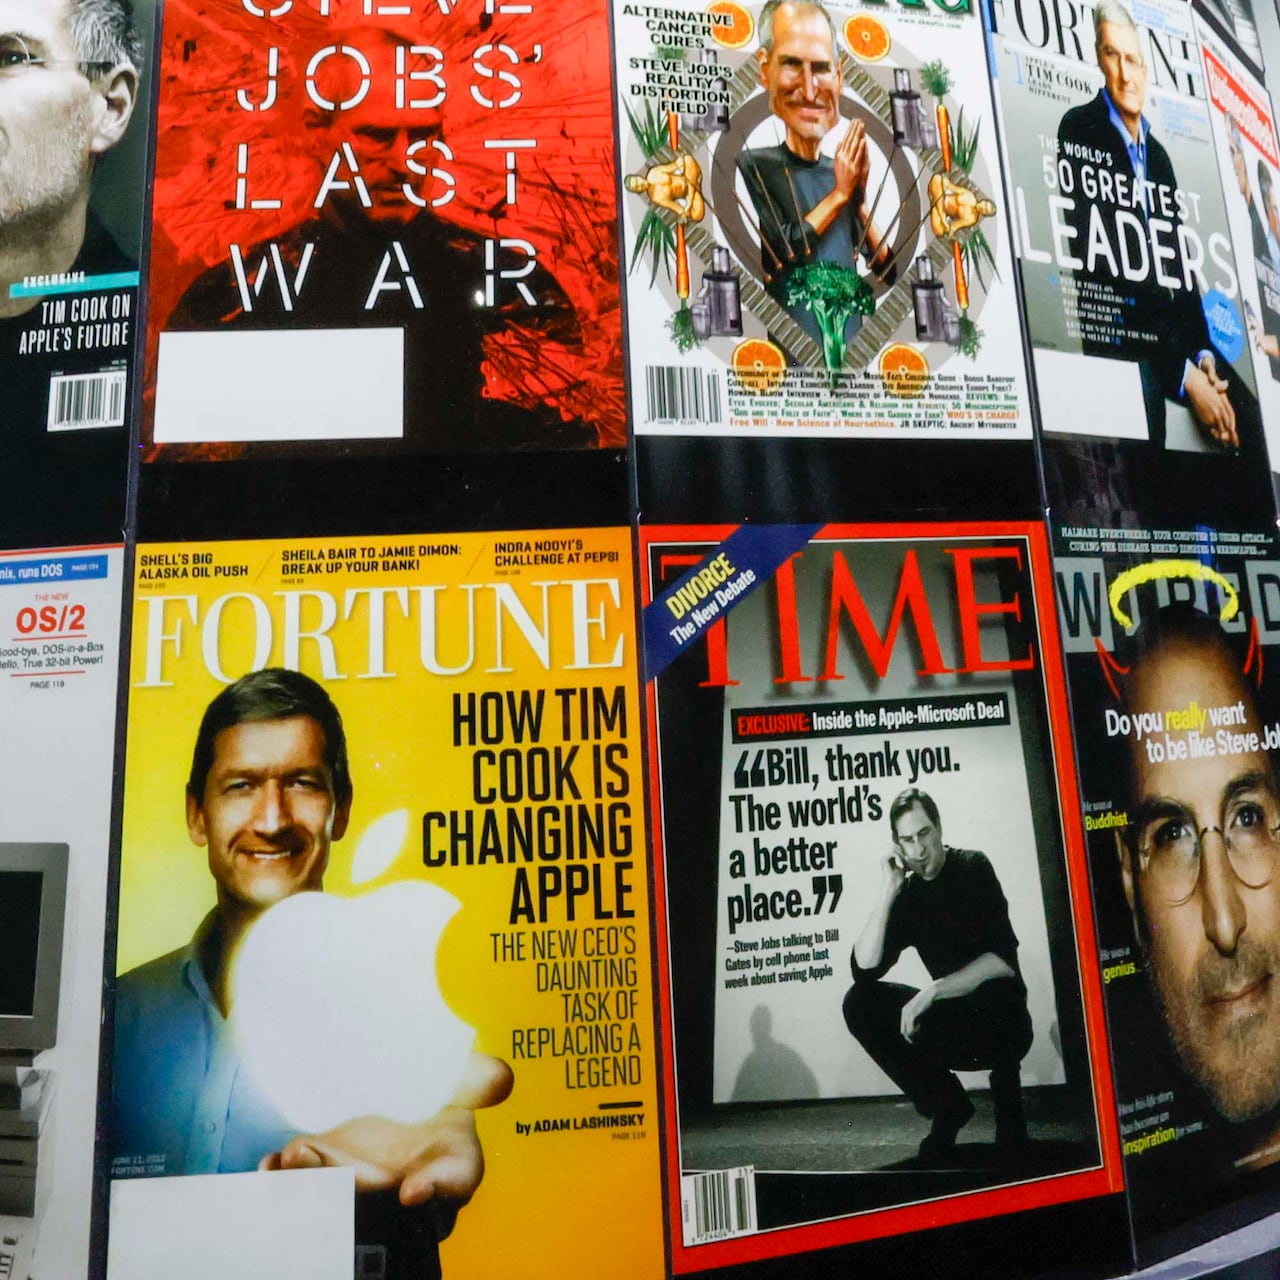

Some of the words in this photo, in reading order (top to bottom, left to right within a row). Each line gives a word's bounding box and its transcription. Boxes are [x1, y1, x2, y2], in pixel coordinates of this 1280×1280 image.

[622, 4, 733, 28] ALTERNATIVE
[646, 19, 712, 37] CANCER
[650, 34, 705, 50] CURES
[236, 43, 543, 112] JOBS'
[629, 57, 682, 73] STEVE
[686, 63, 733, 79] JOB'S
[646, 72, 714, 89] REALITY
[1026, 65, 1053, 85] TIM
[1056, 73, 1093, 96] COOK
[630, 85, 731, 105] DISTORTION
[660, 100, 708, 117] FIELD
[1038, 134, 1061, 154] THE
[1064, 141, 1114, 166] WORLD'S
[235, 139, 537, 209] LAST
[1041, 156, 1075, 195] 50
[1080, 164, 1202, 224] GREATEST
[1016, 186, 1239, 300] LEADERS
[23, 272, 85, 288] EXCLUSIVE
[228, 238, 538, 313] WAR
[42, 301, 66, 325] TIM
[71, 296, 108, 322] COOK
[112, 294, 131, 318] ON
[19, 327, 72, 355] APPLE'S
[77, 322, 129, 349] FUTURE
[665, 552, 736, 620] DIVORCE
[16, 604, 86, 635] OS/2
[134, 578, 625, 689] FORTUNE
[661, 547, 1035, 688] TIME
[453, 689, 546, 748] HOW
[554, 686, 628, 741] TIM
[737, 713, 810, 735] EXCLUSIVE:
[812, 712, 852, 730] Inside
[854, 713, 876, 729] the
[879, 703, 975, 730] Apple-Microsoft
[978, 700, 1005, 720] Deal
[1105, 709, 1130, 737] Do
[1134, 710, 1164, 741] you
[1165, 701, 1207, 734] really
[1208, 701, 1247, 726] want
[825, 740, 901, 782] thank
[907, 743, 961, 784] you.
[1146, 741, 1164, 763] to
[1167, 738, 1187, 762] be
[1191, 732, 1216, 757] like
[1217, 730, 1258, 755] Steve
[472, 746, 583, 805] COOK
[593, 742, 629, 799] IS
[729, 795, 781, 833] The
[789, 784, 882, 828] world's
[423, 802, 632, 867] CHANGING
[729, 848, 746, 878] a
[754, 839, 838, 874] better
[509, 862, 636, 925] APPLE
